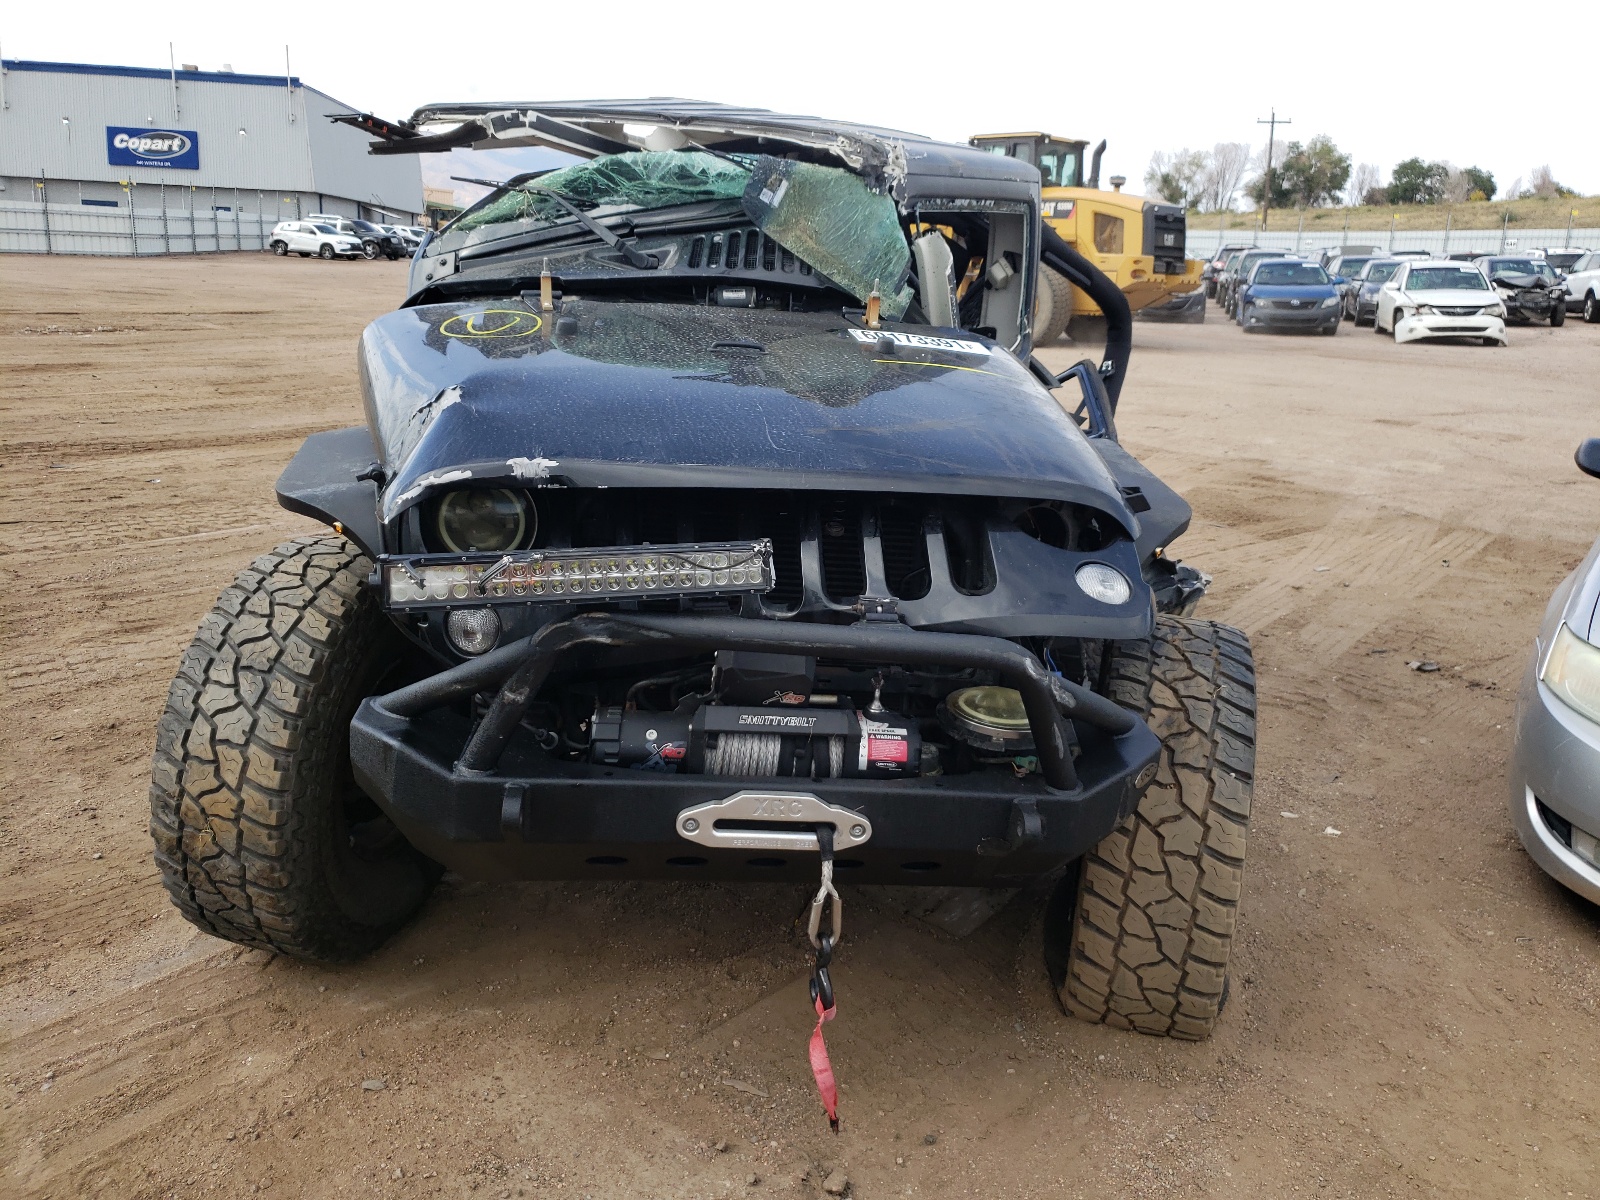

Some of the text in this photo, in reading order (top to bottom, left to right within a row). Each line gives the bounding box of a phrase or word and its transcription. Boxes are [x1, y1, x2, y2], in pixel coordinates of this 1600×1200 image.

[113, 133, 182, 152] Copart
[1164, 234, 1174, 246] CAT
[739, 714, 817, 727] SMITTYBILT
[752, 798, 803, 817] XRC
